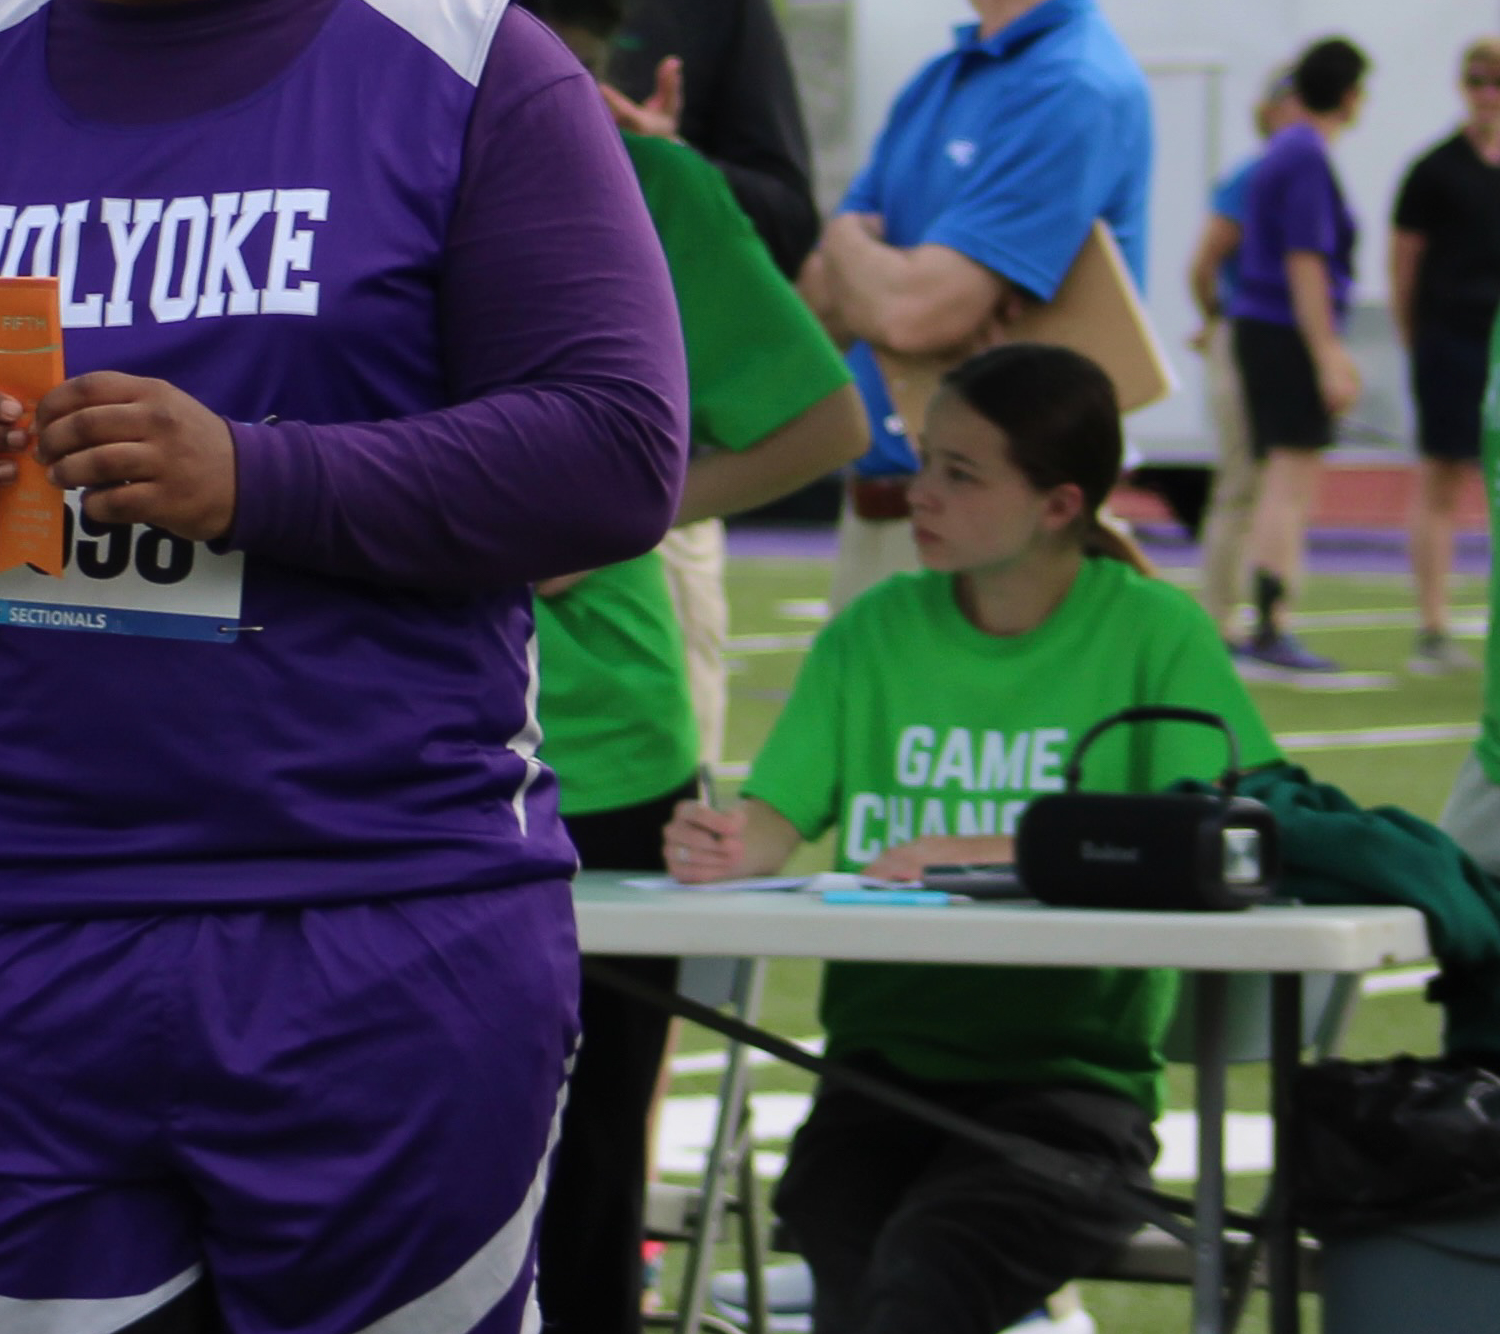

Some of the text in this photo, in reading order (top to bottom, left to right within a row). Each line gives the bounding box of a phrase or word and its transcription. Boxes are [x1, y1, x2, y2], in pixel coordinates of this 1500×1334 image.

[2, 316, 47, 331] FIFTH
[25, 488, 195, 585] 98
[9, 606, 107, 629] SECTIONALS
[896, 724, 1068, 792] GAME
